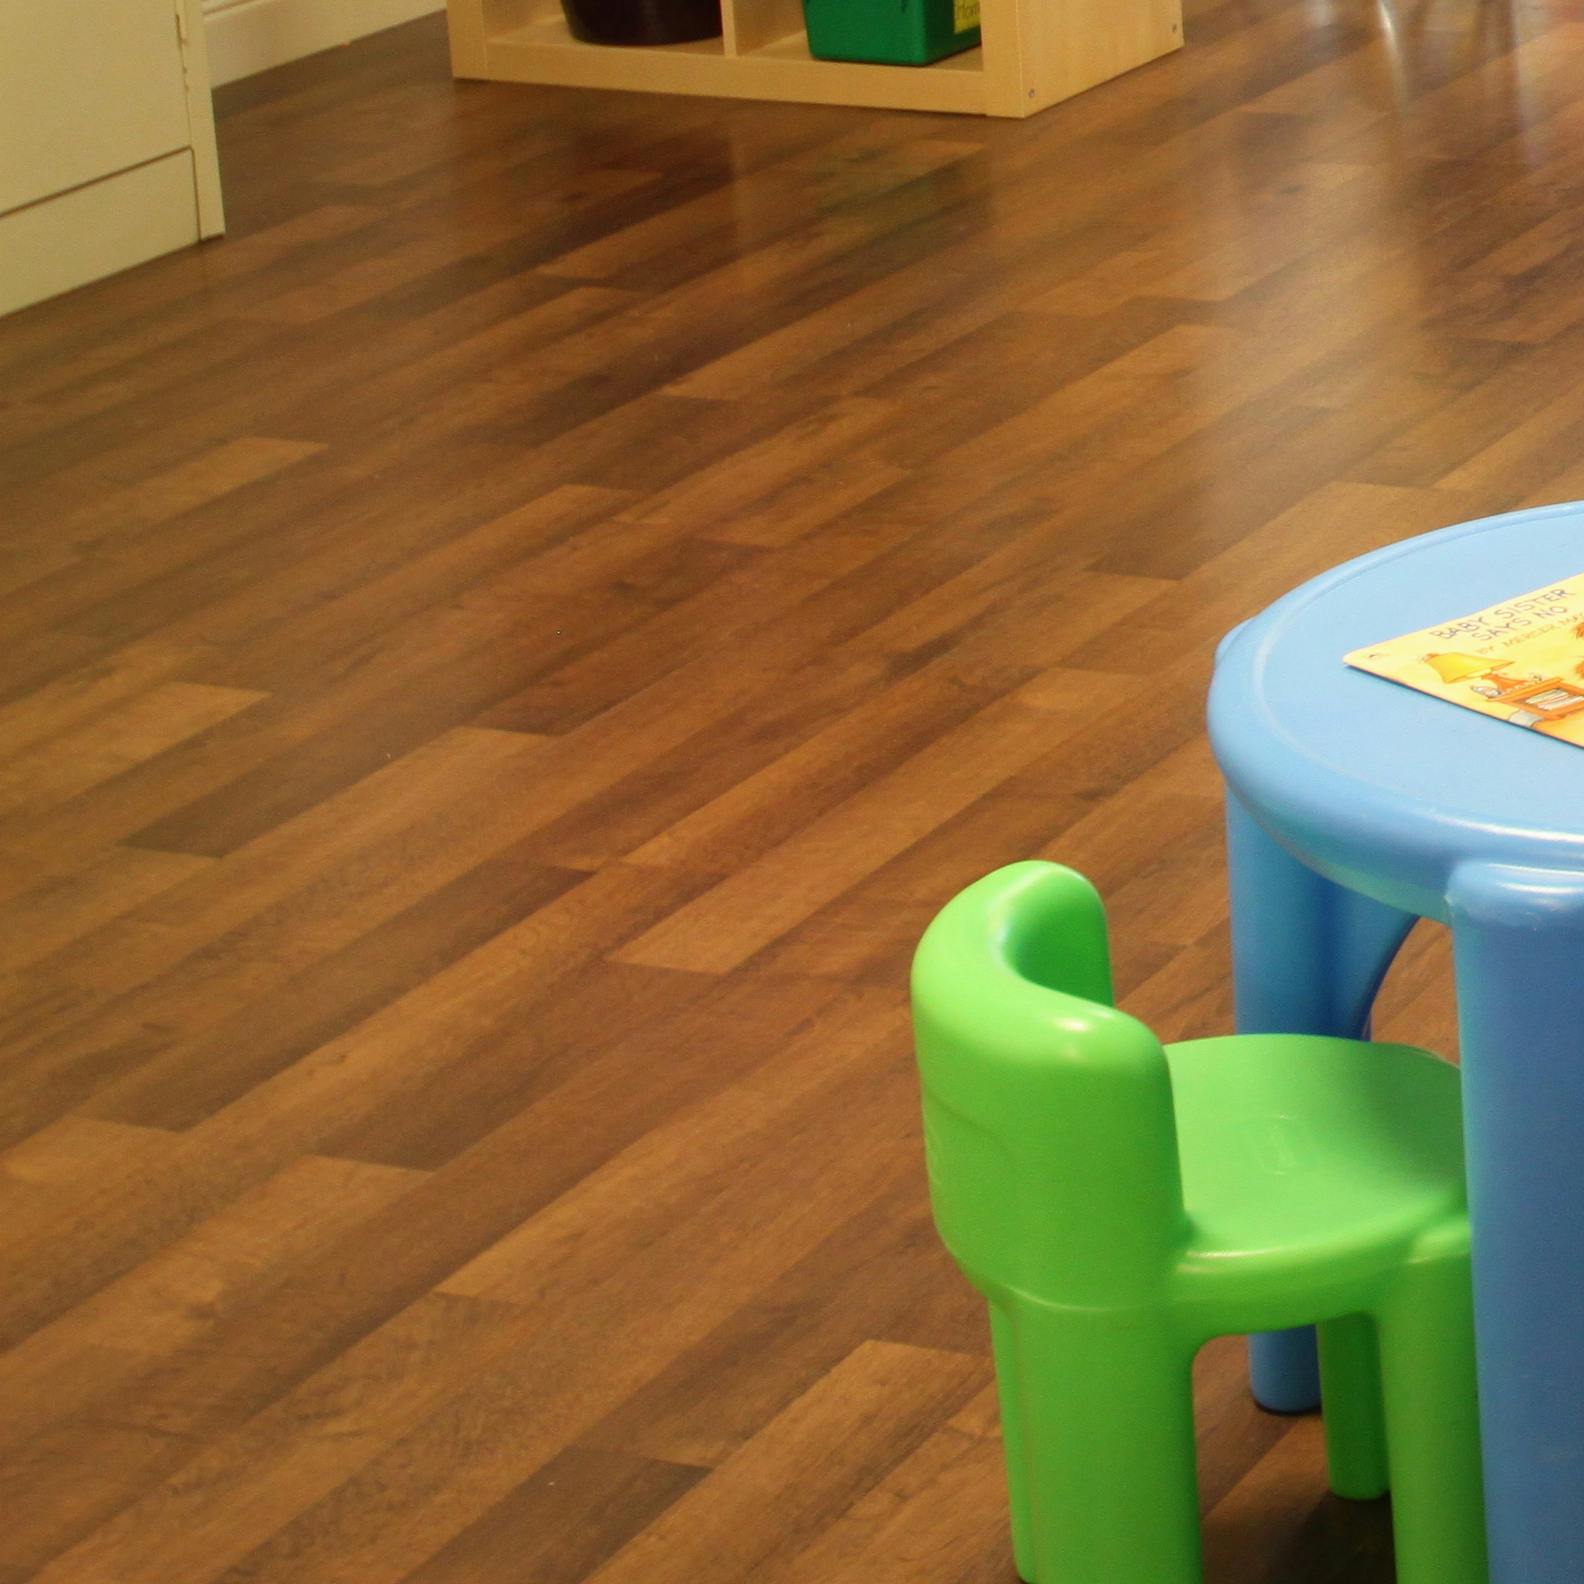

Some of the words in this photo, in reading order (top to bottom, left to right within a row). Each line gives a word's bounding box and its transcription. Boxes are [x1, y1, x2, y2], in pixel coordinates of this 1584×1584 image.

[1430, 615, 1486, 641] BABY
[1495, 587, 1577, 618] SISTER
[1472, 617, 1532, 642] SAYS
[1536, 604, 1569, 620] NO
[1503, 623, 1555, 647] MERCER
